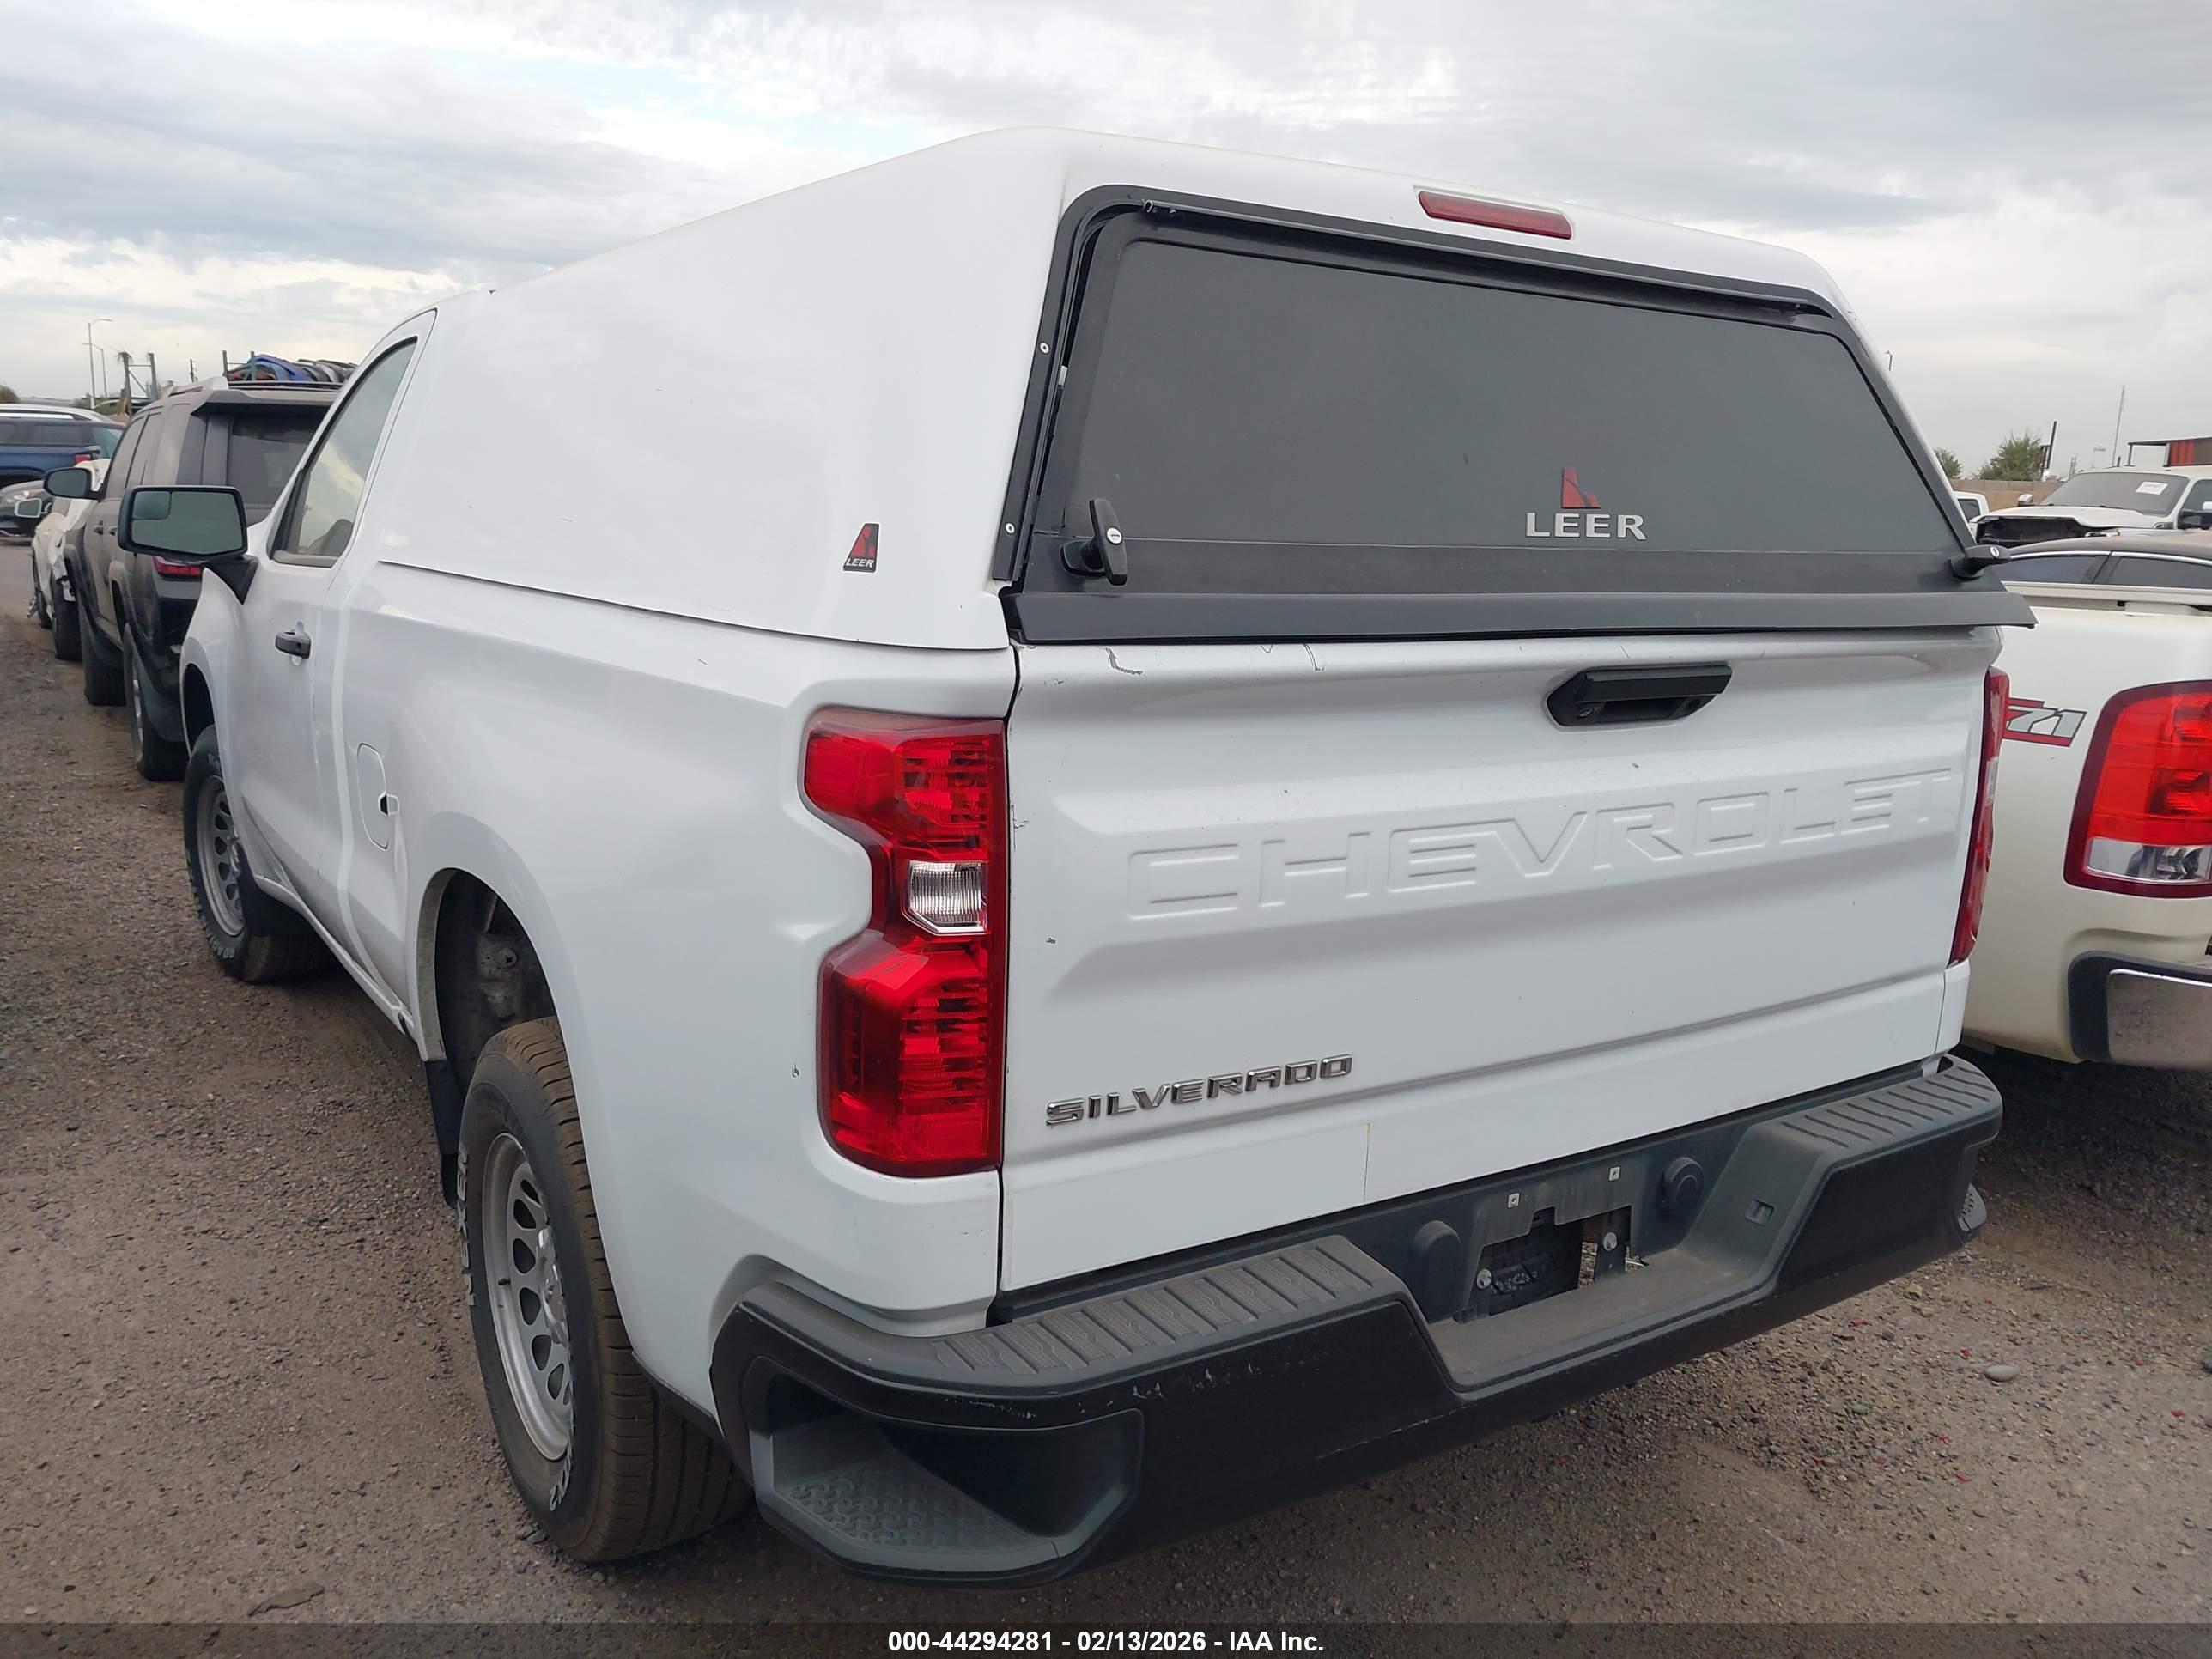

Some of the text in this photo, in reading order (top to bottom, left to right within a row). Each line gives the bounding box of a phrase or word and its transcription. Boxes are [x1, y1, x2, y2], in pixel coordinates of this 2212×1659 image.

[1525, 512, 1648, 541] LEER
[845, 557, 875, 568] LEER
[1127, 768, 1952, 920] CHEVROLET
[1045, 1054, 1352, 1128] SILVERADO
